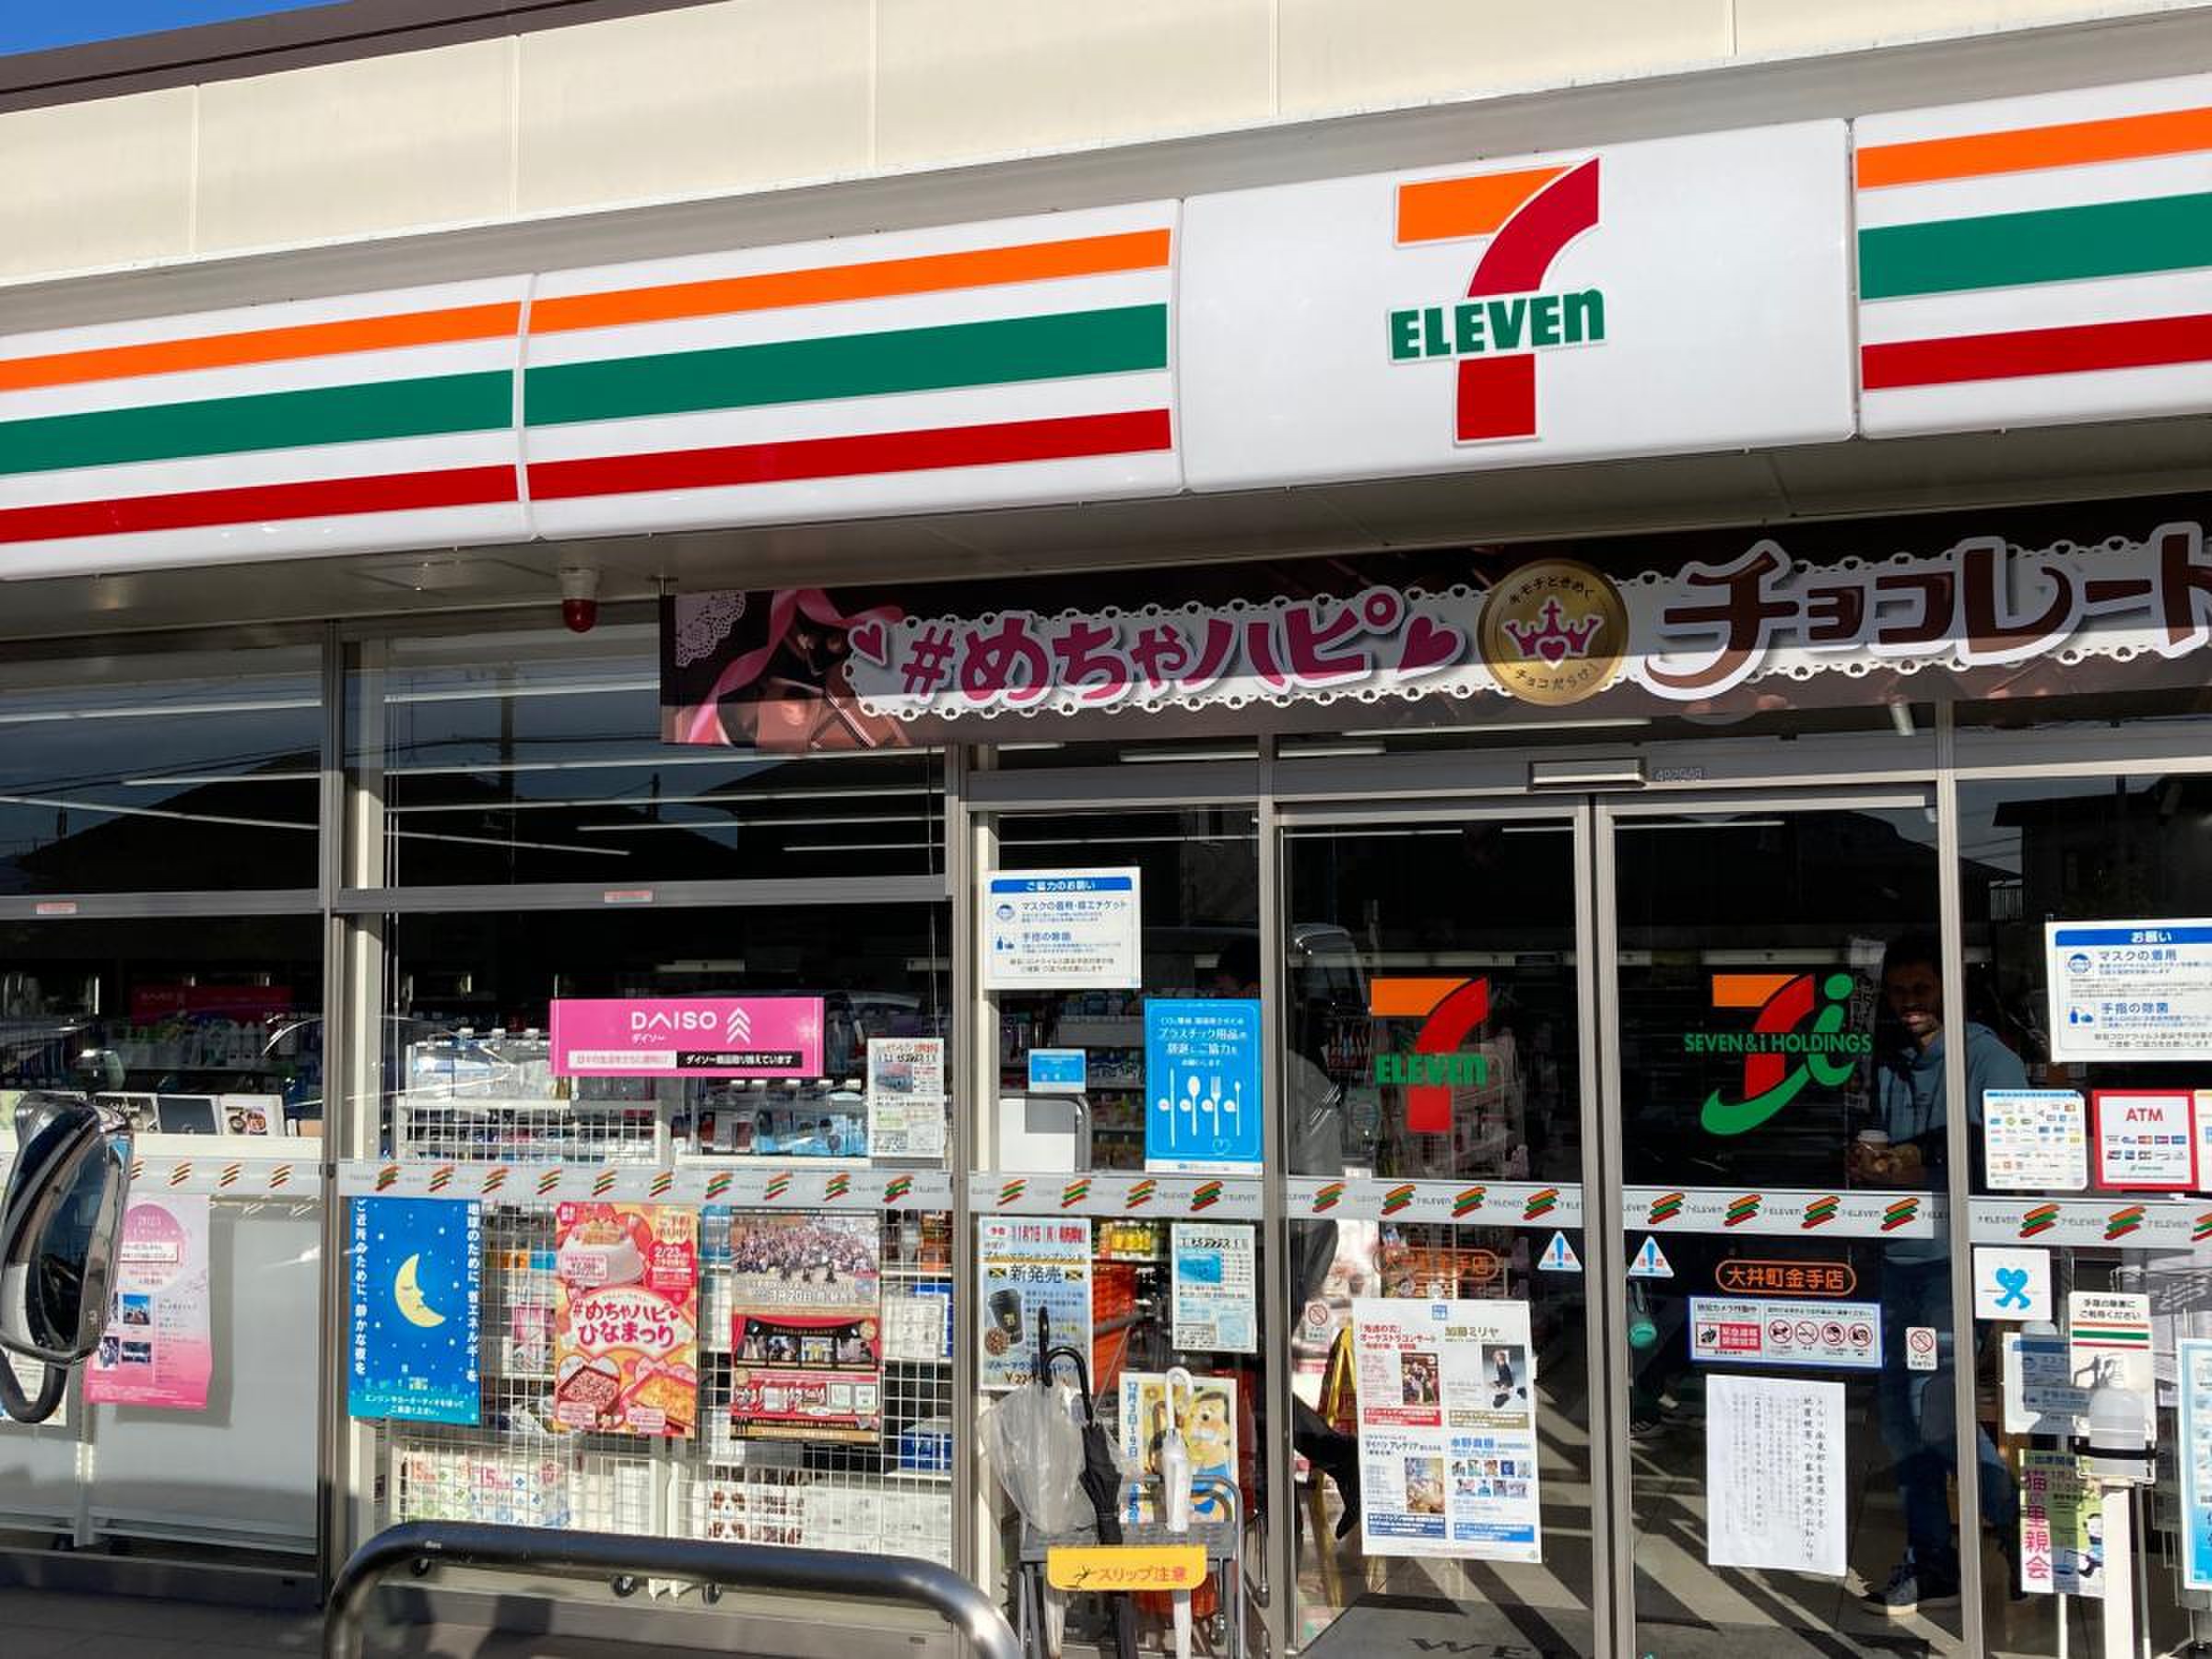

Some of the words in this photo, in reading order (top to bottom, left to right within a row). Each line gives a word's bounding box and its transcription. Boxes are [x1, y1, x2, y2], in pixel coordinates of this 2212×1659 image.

[1026, 881, 1096, 892] ご協力のお願い
[2132, 930, 2172, 943] お願い
[2099, 949, 2177, 960] マスクの着用
[2100, 1002, 2169, 1014] 手指の除菌
[631, 1011, 718, 1030] DAISO
[631, 1033, 665, 1043] ダイソー
[1771, 1033, 1872, 1053] HOLDINGS
[2125, 1108, 2164, 1122] ATM
[1009, 1264, 1063, 1284] 新発売
[1726, 1267, 1844, 1289] 大井町金手店
[2079, 1310, 2141, 1320] ご利用ください
[578, 1324, 675, 1348] ひなまつり
[1445, 1326, 1500, 1337] 加藤ミリヤ
[1098, 1565, 1188, 1583] スリップ注意
